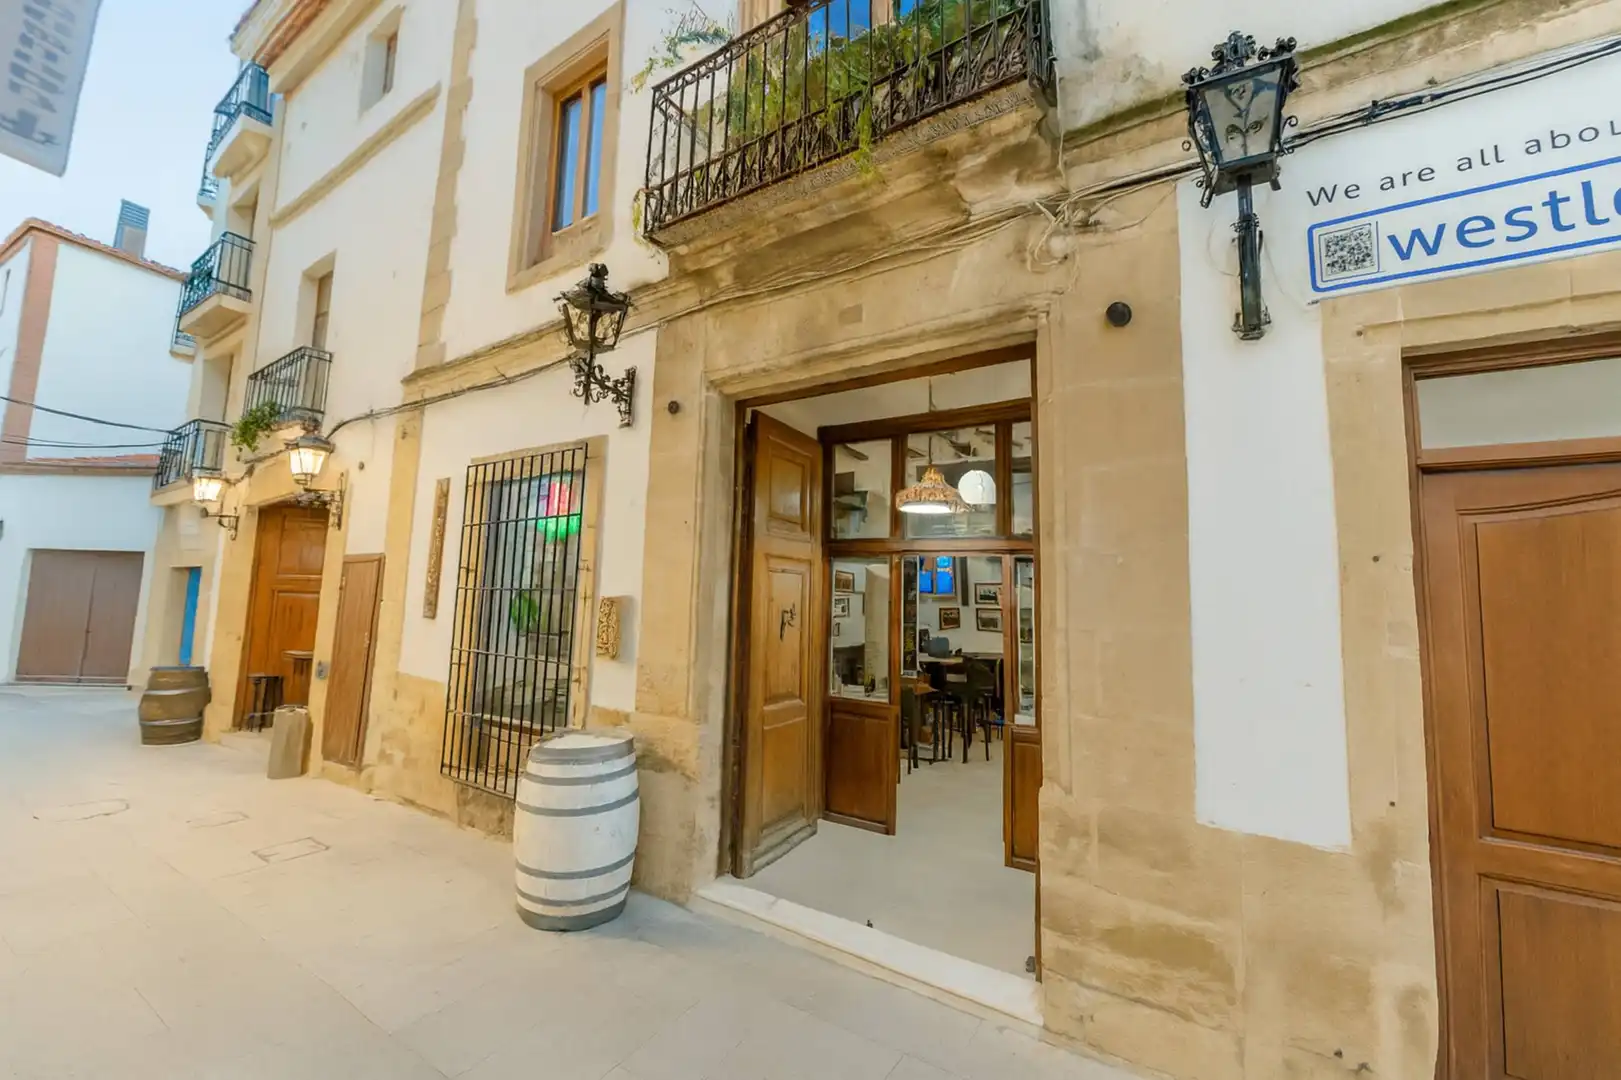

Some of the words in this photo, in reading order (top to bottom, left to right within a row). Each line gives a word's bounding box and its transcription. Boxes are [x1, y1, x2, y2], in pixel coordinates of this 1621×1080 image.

[1306, 184, 1360, 206] We
[1379, 167, 1435, 190] are
[1456, 145, 1504, 171] all
[1387, 181, 1621, 261] westl
